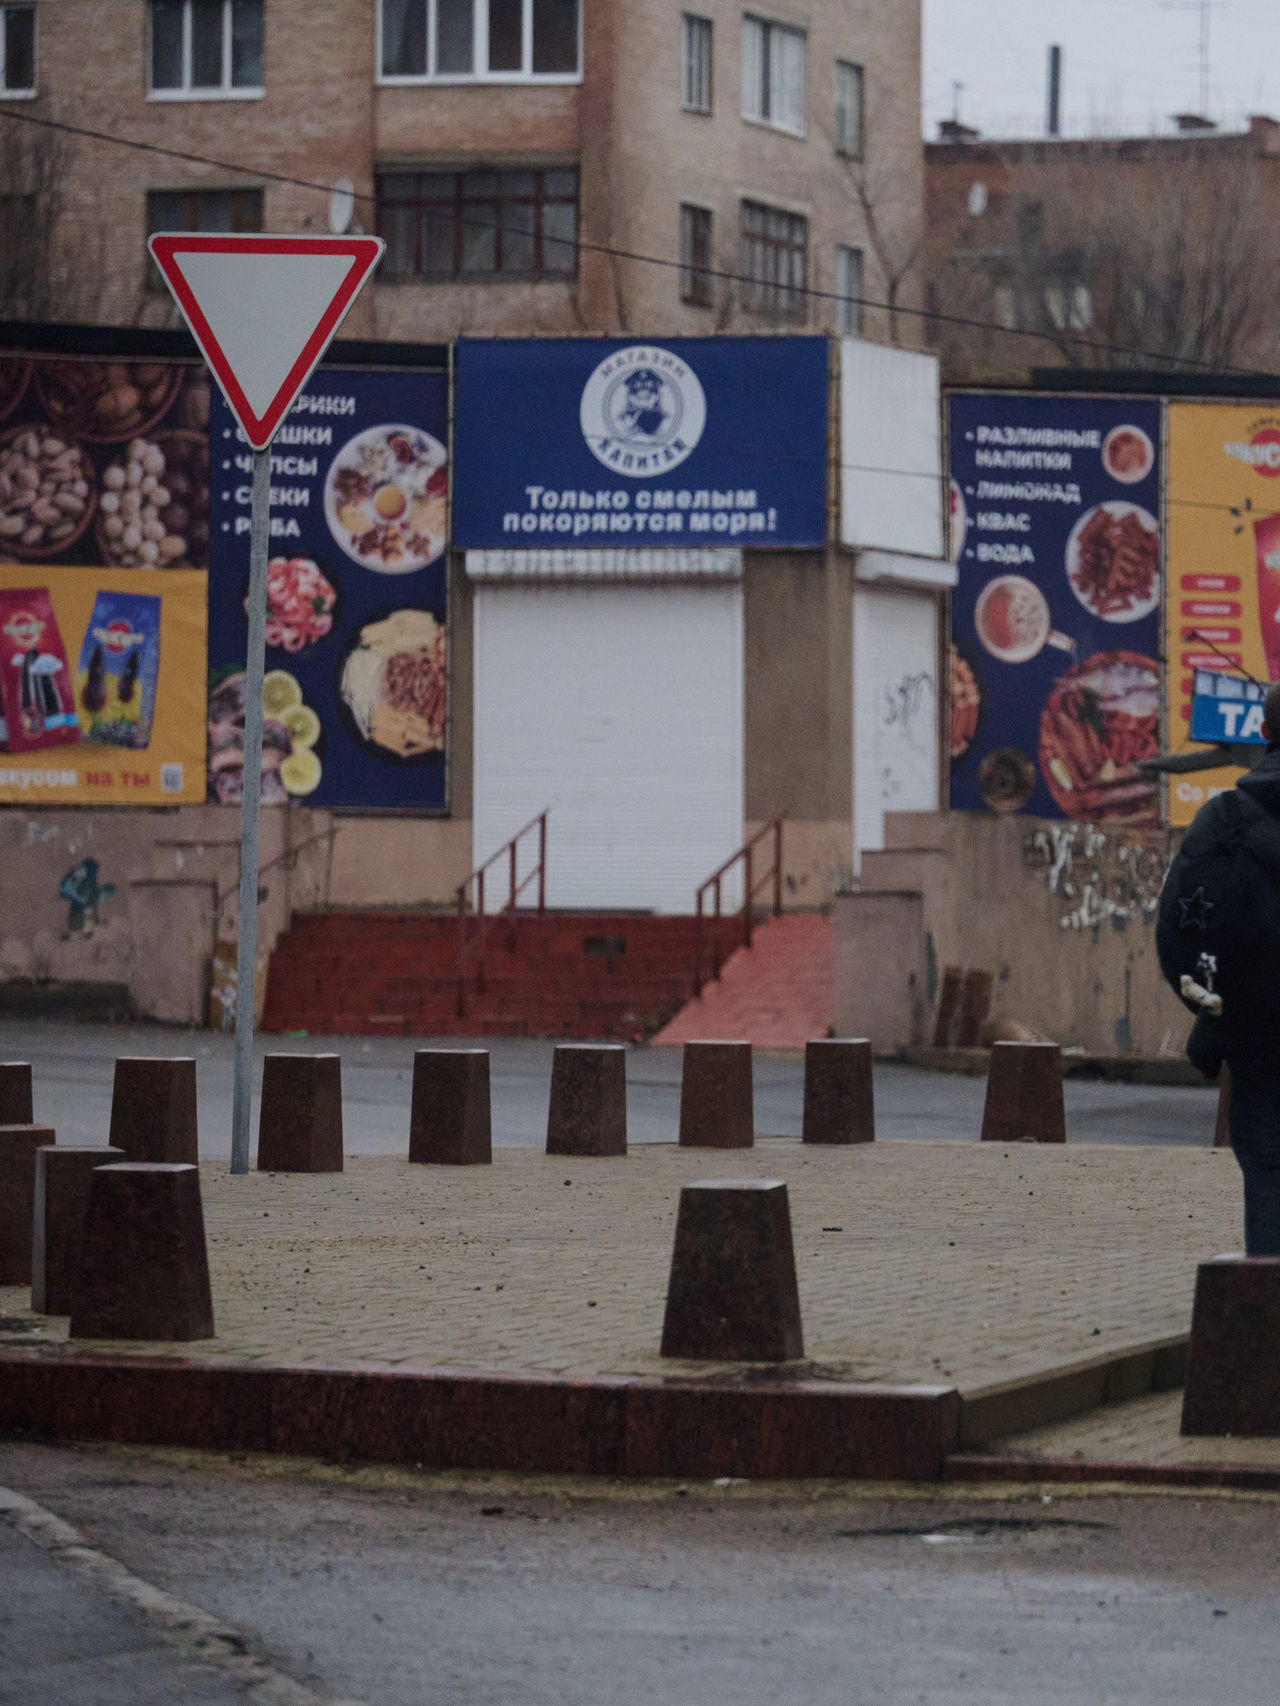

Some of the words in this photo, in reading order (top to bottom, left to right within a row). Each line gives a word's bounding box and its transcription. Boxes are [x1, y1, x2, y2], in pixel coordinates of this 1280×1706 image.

[976, 425, 1102, 449] РАЗЛИВНЫЕ
[234, 455, 319, 476] ЧПСЫ
[975, 448, 1072, 471] НАПИТКИ
[234, 485, 311, 508] СЕКИ
[525, 486, 630, 510] Только
[634, 489, 758, 510] смелым
[976, 480, 1082, 505] ЛИМОНАД
[234, 516, 302, 539] РБА
[503, 512, 684, 537] покоряются
[688, 507, 778, 537] моря!
[976, 511, 1032, 533] КВАС
[976, 542, 1036, 565] ВОДА
